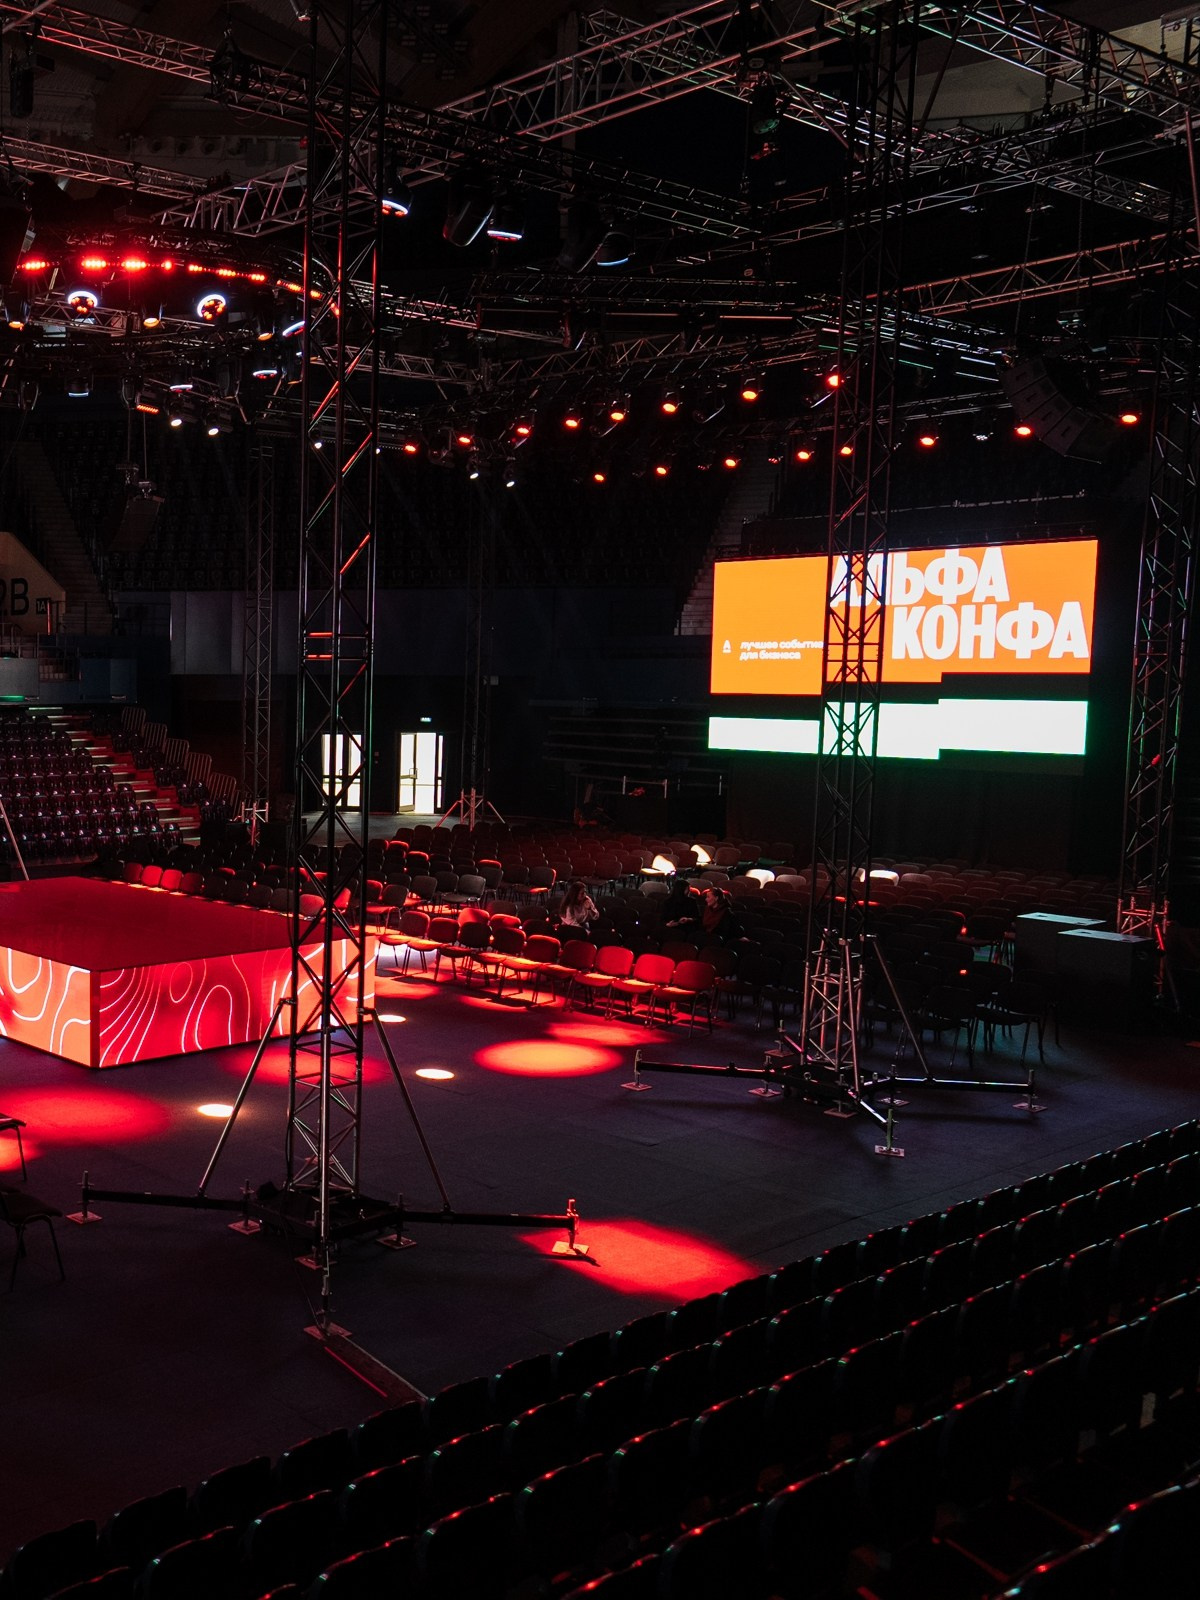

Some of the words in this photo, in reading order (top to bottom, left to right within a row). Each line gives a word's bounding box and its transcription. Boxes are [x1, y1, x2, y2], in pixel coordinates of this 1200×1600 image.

[830, 547, 1010, 607] АЛЬФА
[739, 651, 758, 661] для
[759, 650, 801, 659] бизнеса
[891, 601, 1089, 660] КОНФА
